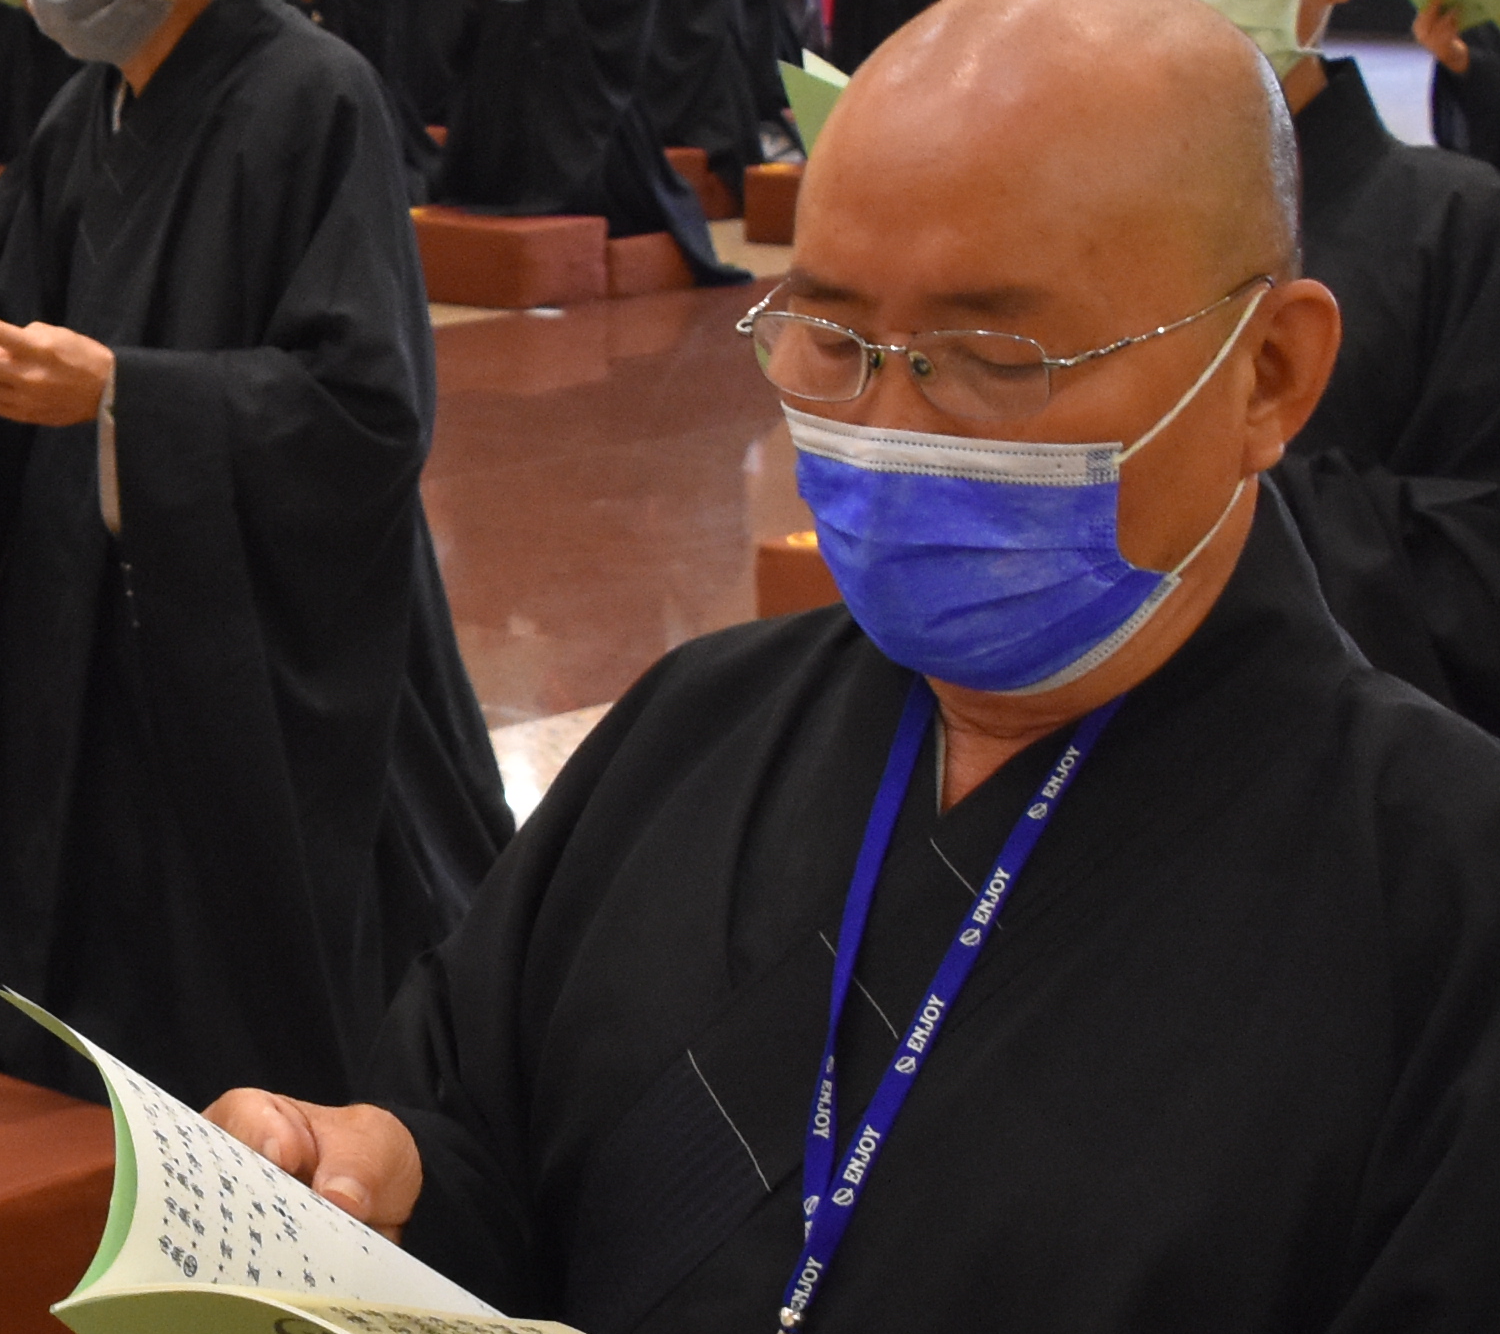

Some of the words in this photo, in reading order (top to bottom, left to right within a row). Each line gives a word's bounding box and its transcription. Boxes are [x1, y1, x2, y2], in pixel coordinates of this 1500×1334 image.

[1041, 745, 1081, 799] ENJOY
[971, 866, 1010, 926] ENJOY
[907, 994, 945, 1053] ENJOY
[812, 1079, 833, 1139] ENJOY
[842, 1124, 881, 1186] ENJOY
